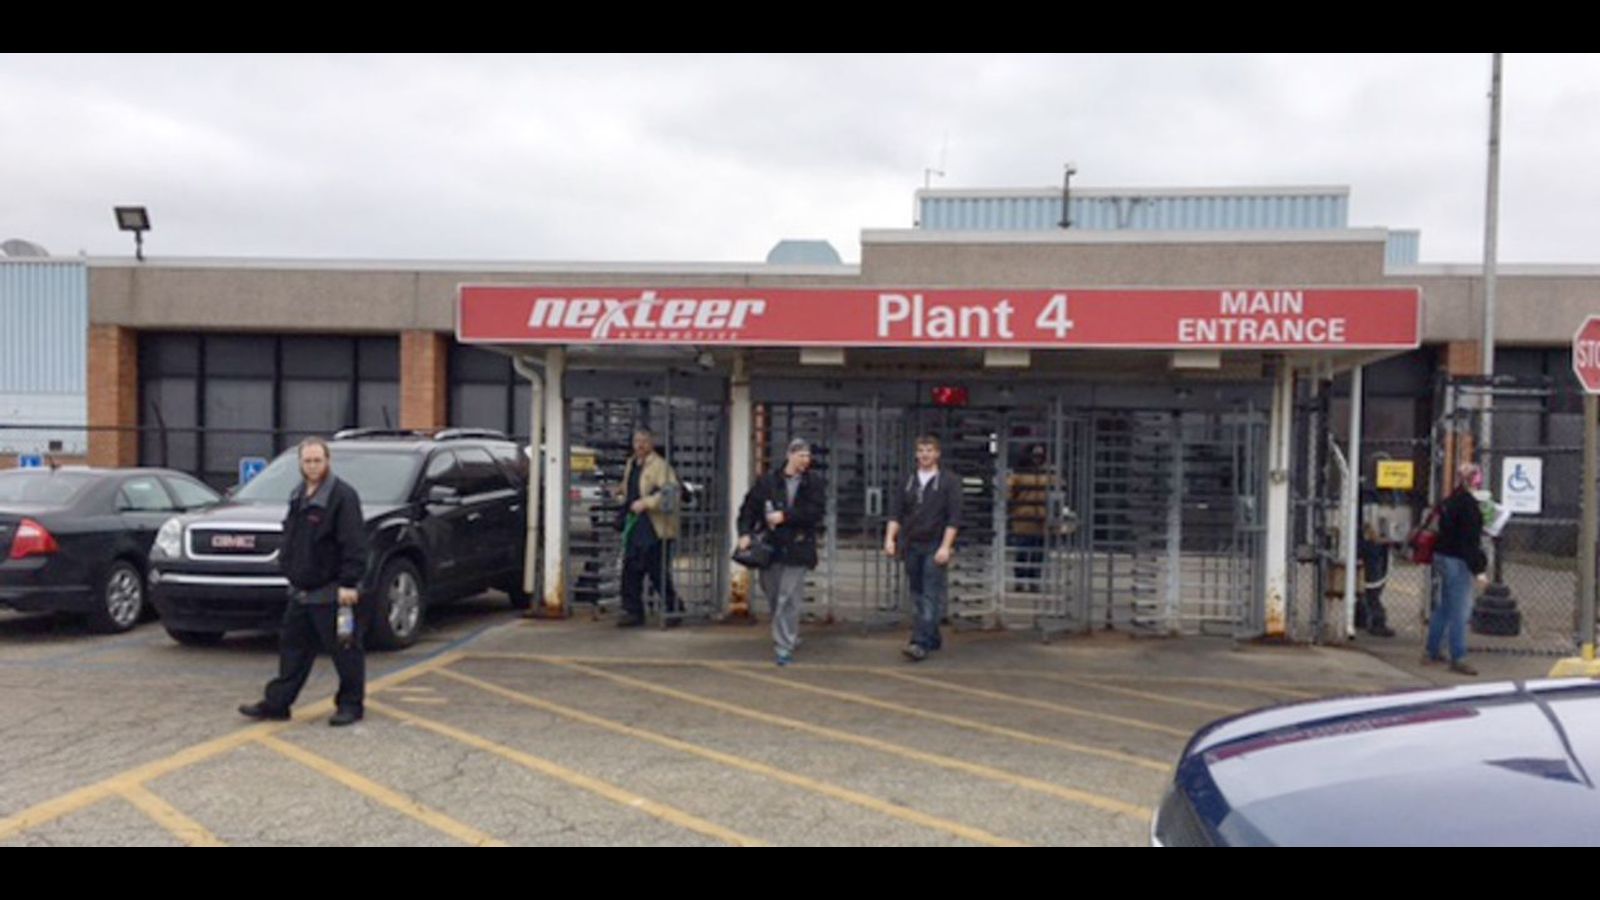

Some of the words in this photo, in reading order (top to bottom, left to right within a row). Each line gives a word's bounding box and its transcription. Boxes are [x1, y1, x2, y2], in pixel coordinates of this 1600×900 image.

[527, 290, 766, 339] nexteer
[877, 293, 1014, 339] Plant
[1035, 293, 1074, 338] 4
[1220, 291, 1304, 314] MAIN
[1178, 318, 1346, 342] ENTRANCE
